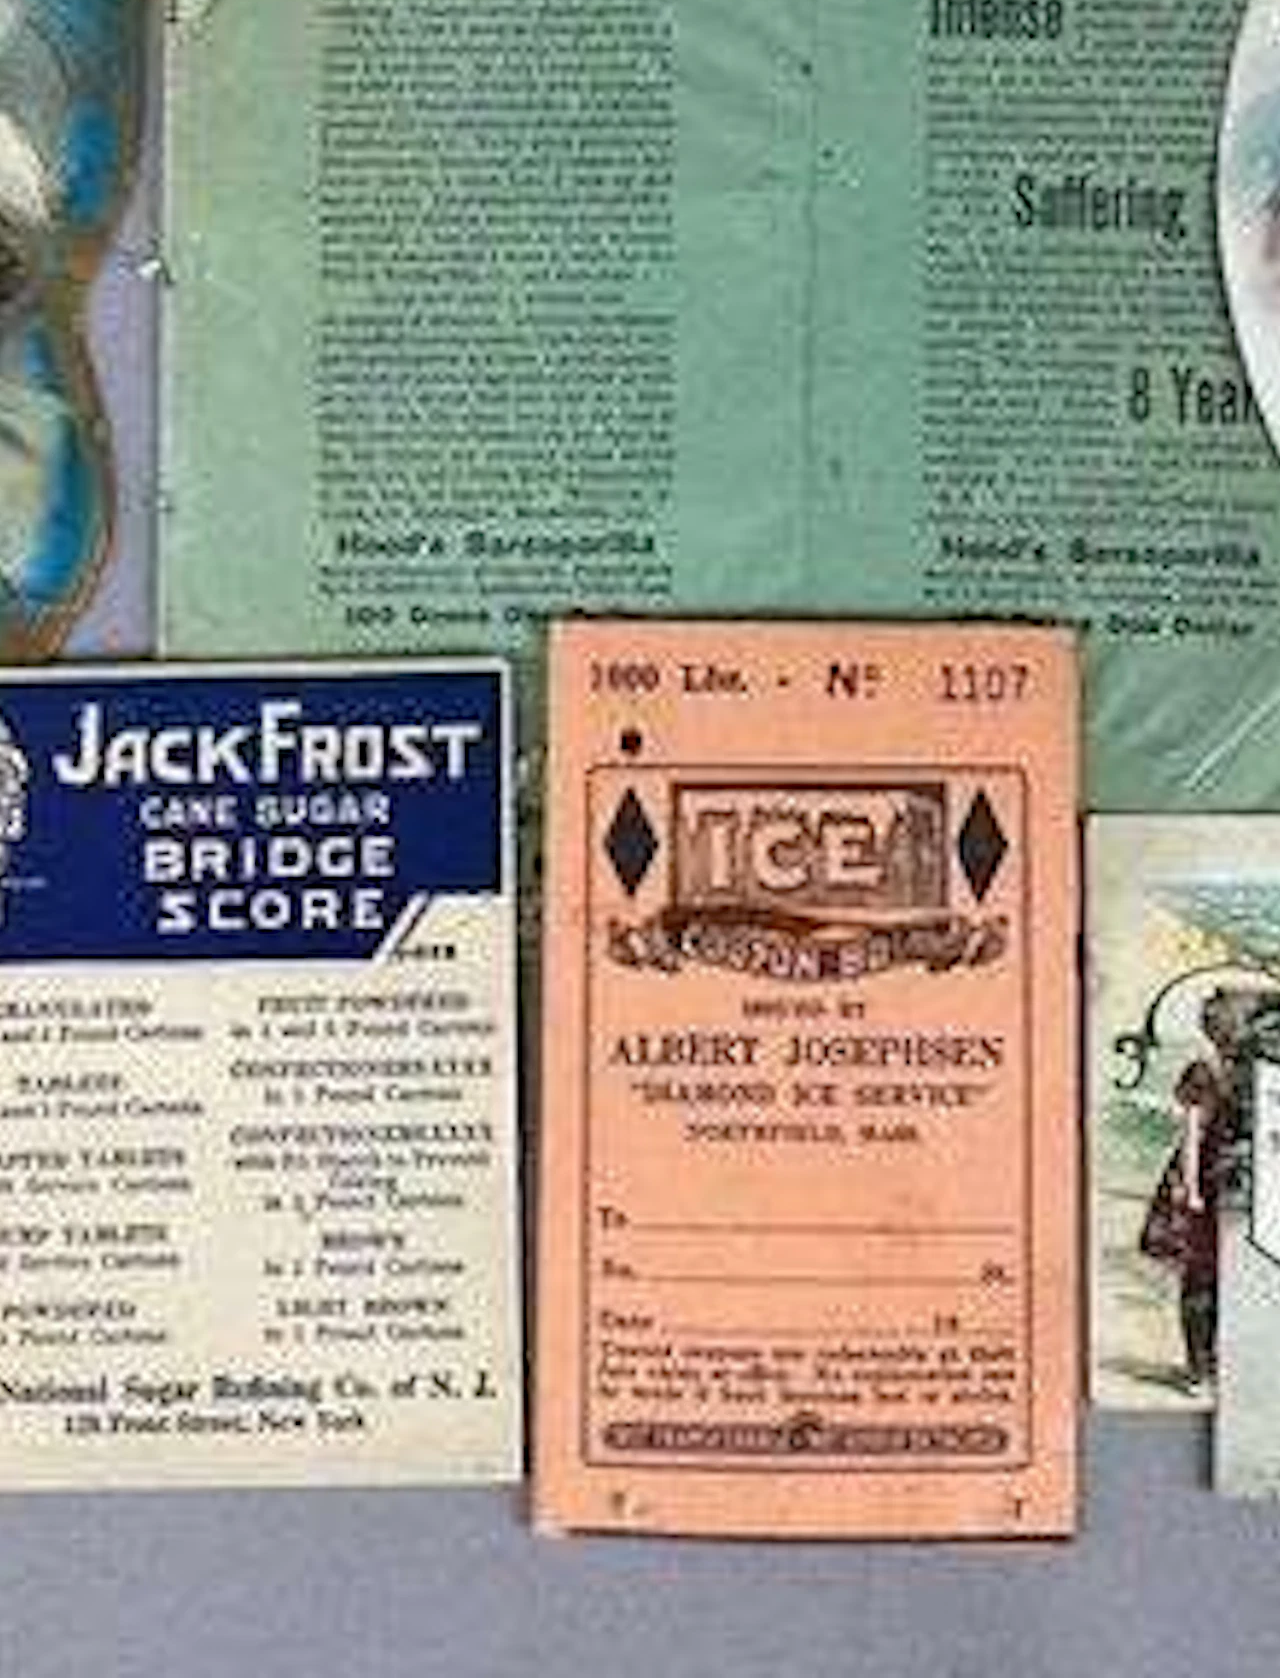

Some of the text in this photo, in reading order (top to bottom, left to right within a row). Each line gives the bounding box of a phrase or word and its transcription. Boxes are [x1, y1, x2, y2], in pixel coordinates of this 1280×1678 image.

[1016, 174, 1188, 242] Suffering
[1129, 367, 1150, 421] 8
[940, 663, 1030, 700] 1107
[52, 701, 483, 785] JACK FROST
[138, 793, 391, 829] CANE SUGAR
[143, 835, 396, 883] BRIDGE
[694, 806, 885, 893] ICE
[157, 889, 386, 932] SCORE
[607, 1033, 1006, 1069] ALBERT JOSEPHSEN
[791, 1083, 843, 1107] ICE
[119, 1375, 200, 1407] Sugar
[333, 1376, 381, 1398] Co.
[391, 1374, 417, 1398] of
[428, 1373, 462, 1399] N.
[474, 1370, 498, 1399] J.
[256, 1410, 305, 1432] New
[314, 1409, 364, 1432] York
